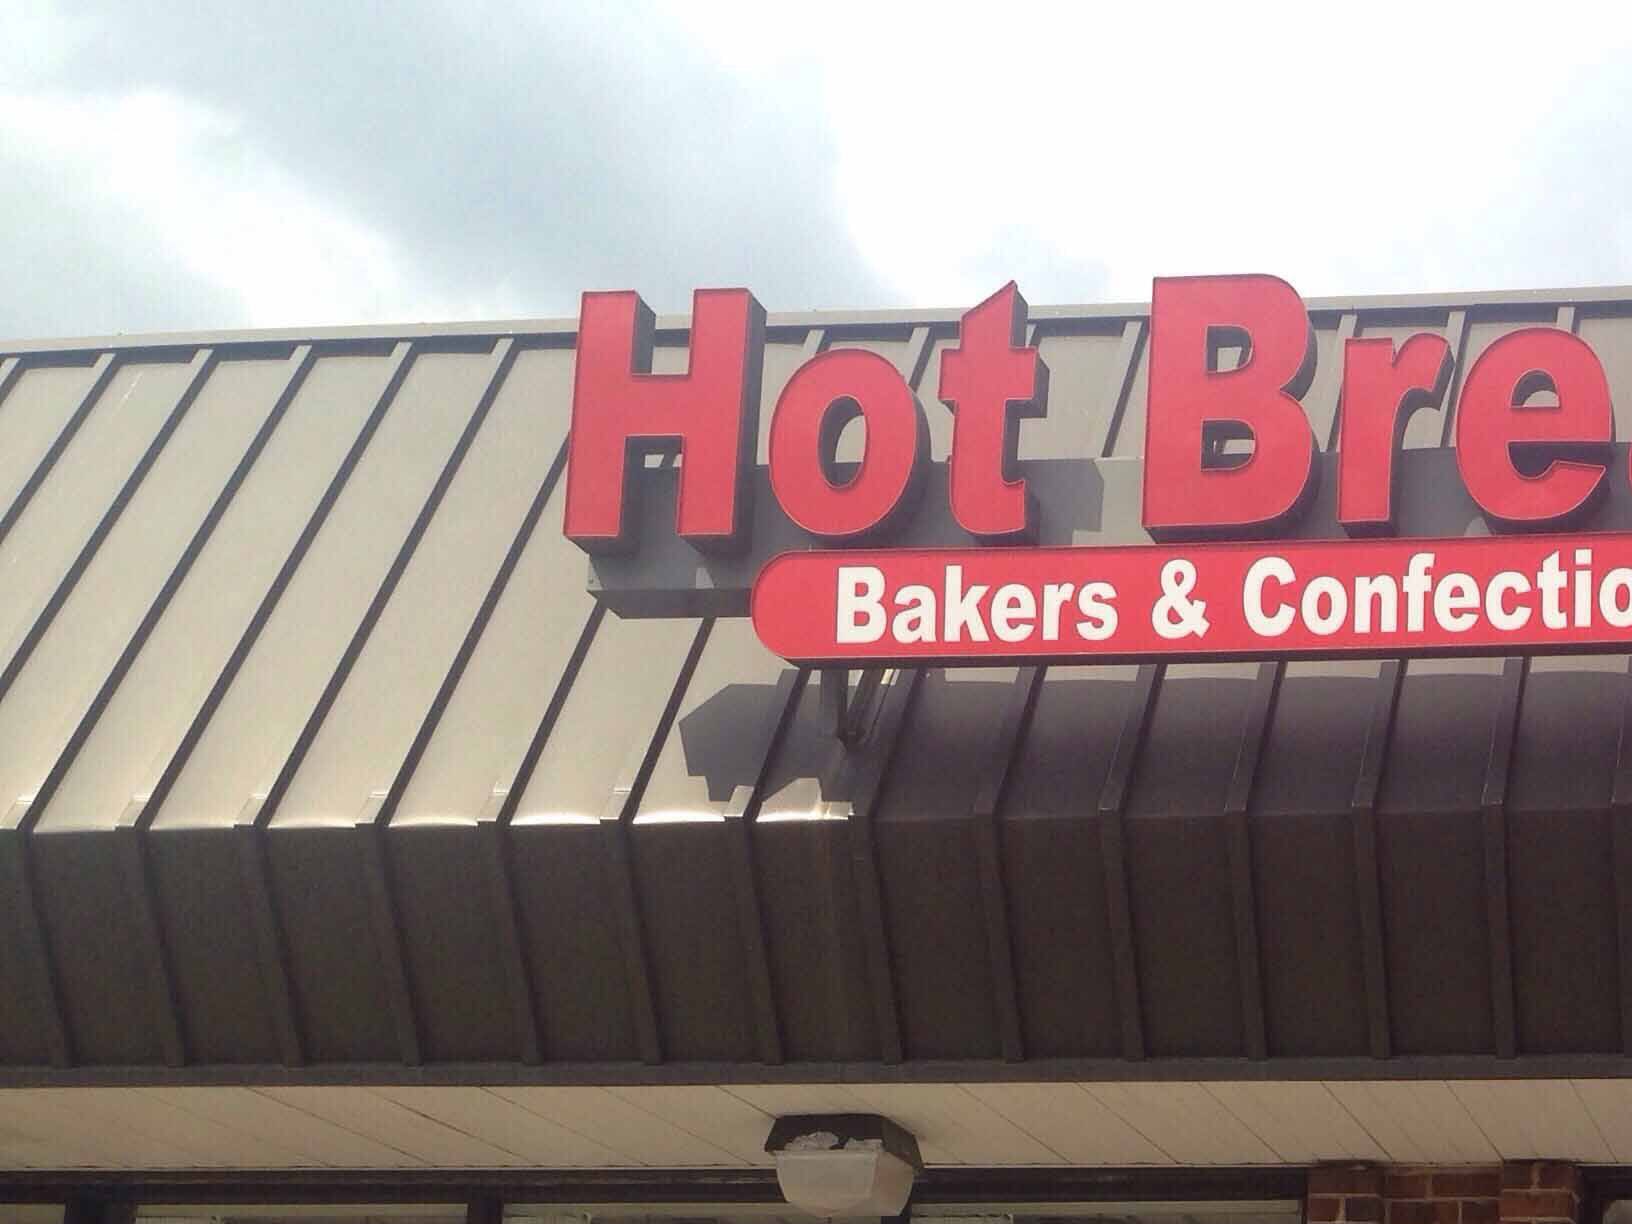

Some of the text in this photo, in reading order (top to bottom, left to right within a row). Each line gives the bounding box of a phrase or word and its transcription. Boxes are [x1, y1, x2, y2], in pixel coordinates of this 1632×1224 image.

[563, 280, 1040, 538] Hot
[836, 563, 1119, 645] Bakers
[1152, 558, 1211, 638] &
